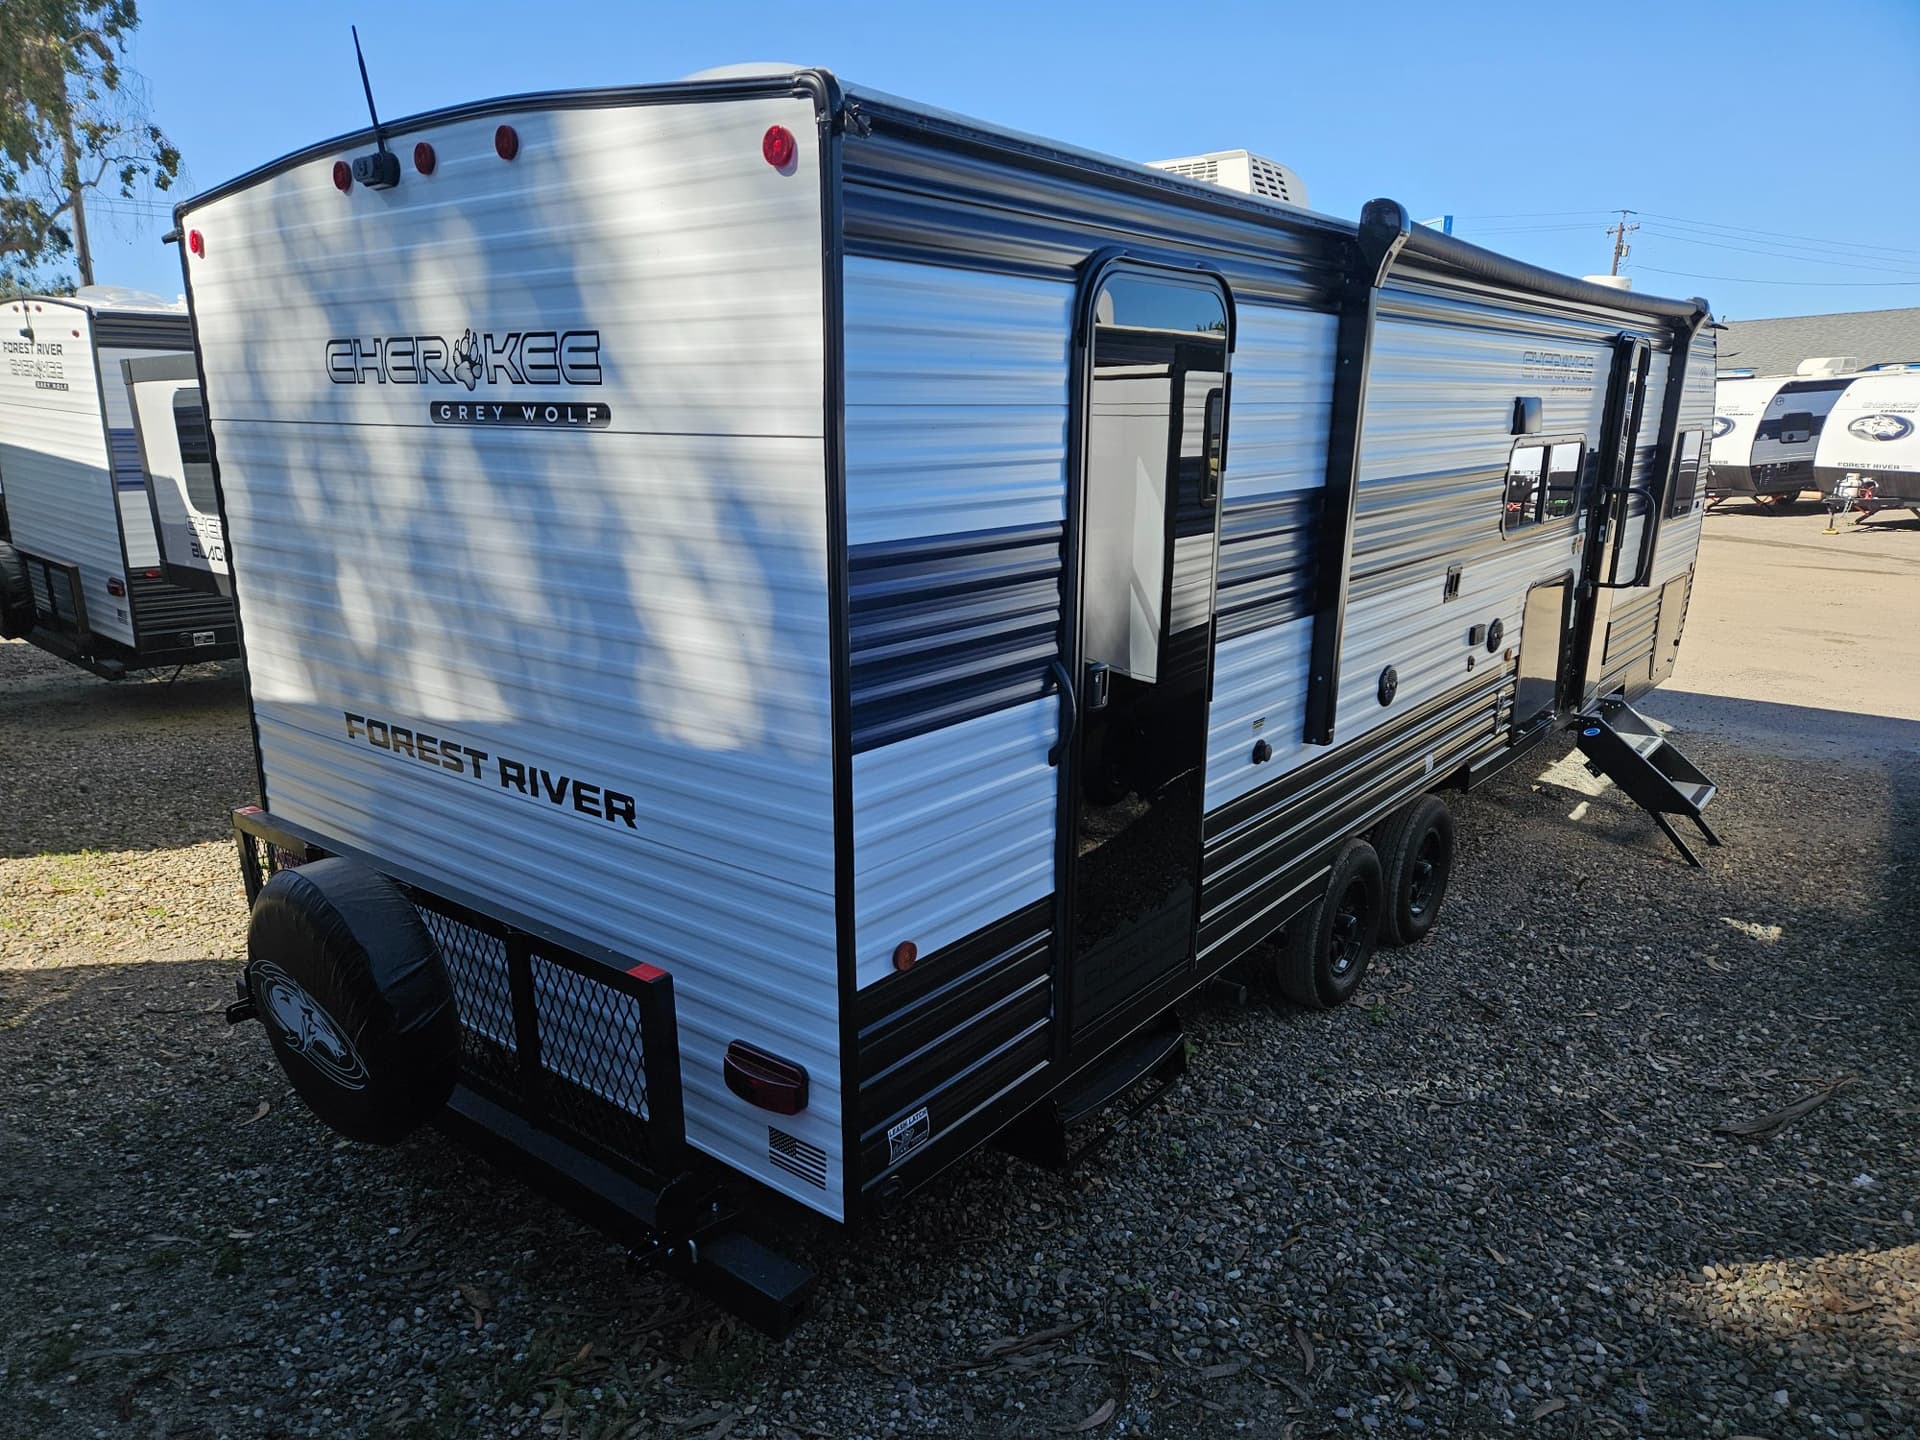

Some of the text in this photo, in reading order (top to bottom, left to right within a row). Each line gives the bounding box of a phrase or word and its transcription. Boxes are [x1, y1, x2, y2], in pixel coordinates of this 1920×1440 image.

[3, 341, 64, 356] FOREST RIVER
[440, 404, 598, 423] GREY WOLF
[343, 711, 638, 830] FOREST RIVER
